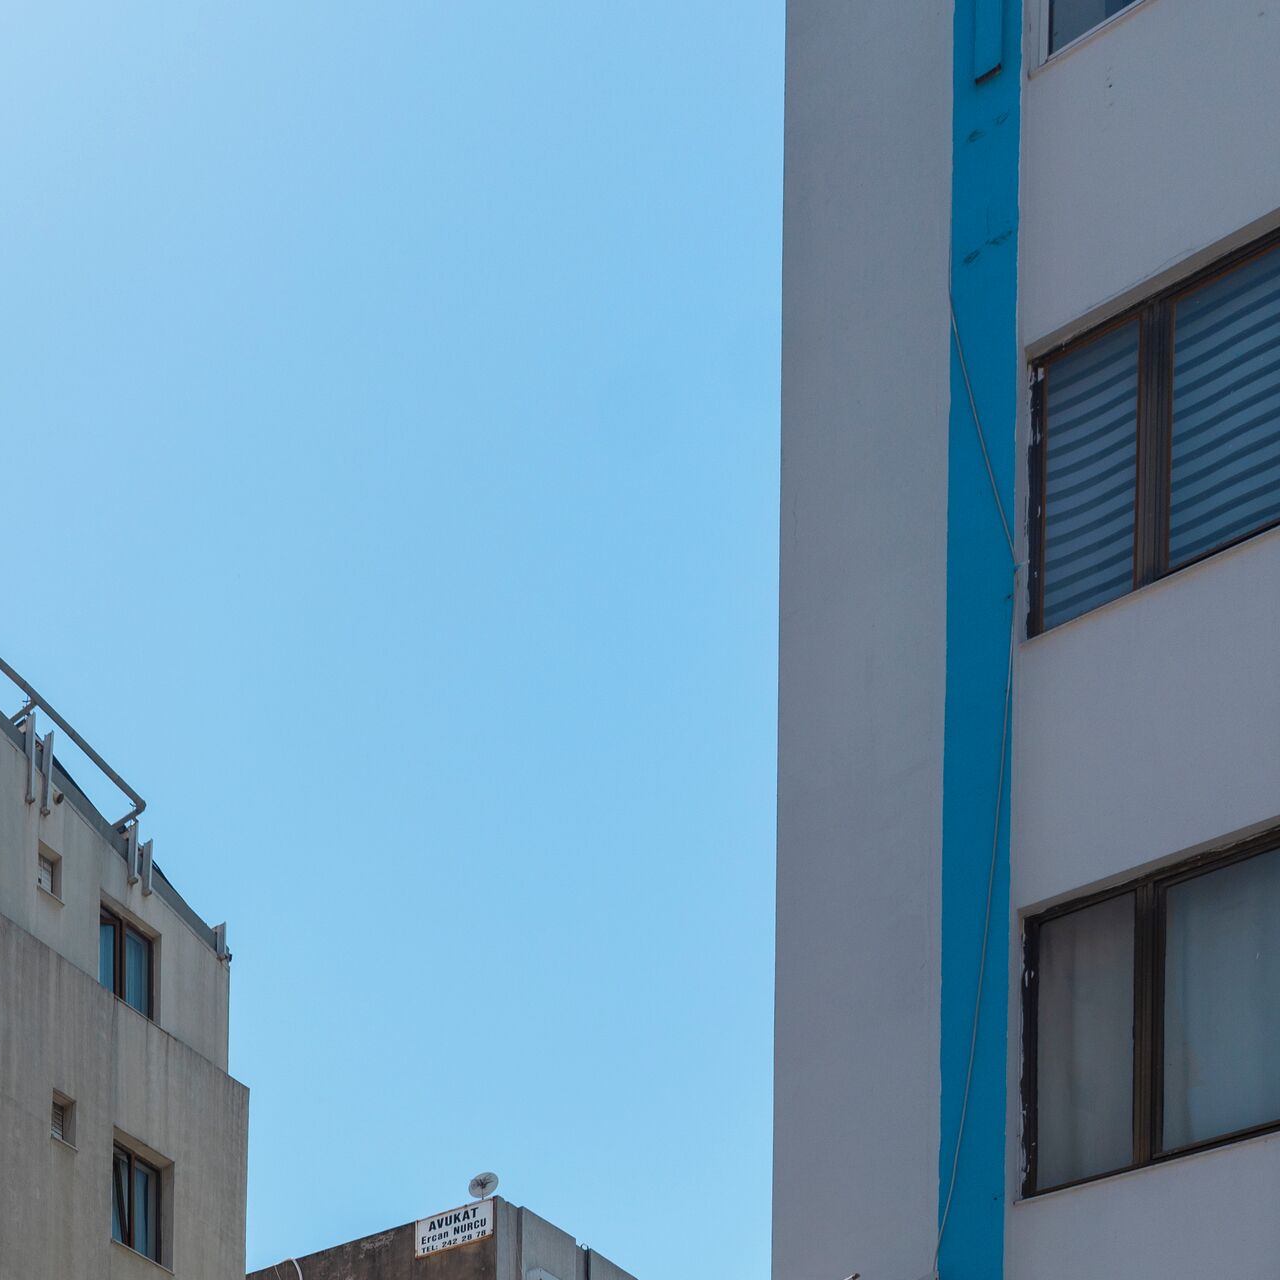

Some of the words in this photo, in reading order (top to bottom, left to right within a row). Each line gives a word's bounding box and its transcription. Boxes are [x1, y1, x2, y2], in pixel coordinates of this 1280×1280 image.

[421, 1231, 449, 1245] Ercan
[453, 1217, 487, 1235] NURCU
[428, 1206, 479, 1232] AVUKAT
[421, 1245, 438, 1254] TEL:
[442, 1238, 458, 1248] 242
